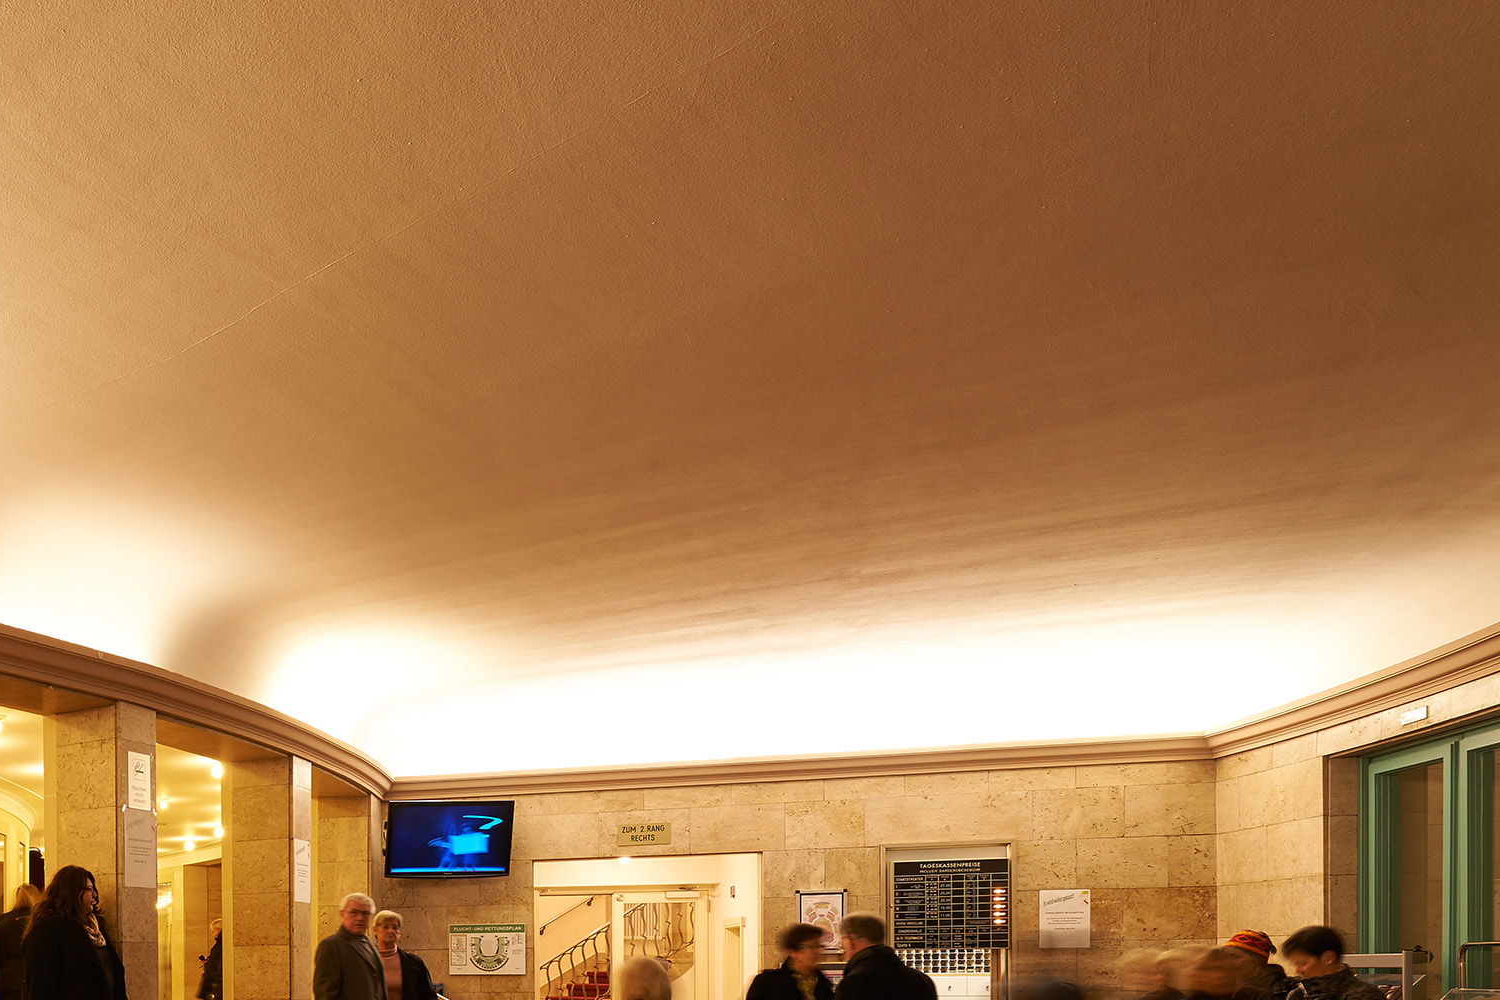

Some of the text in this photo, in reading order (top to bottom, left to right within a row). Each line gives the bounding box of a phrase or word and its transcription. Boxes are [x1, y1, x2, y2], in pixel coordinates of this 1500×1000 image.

[621, 826, 637, 834] ZUM
[646, 824, 665, 832] RANG
[630, 833, 656, 842] RECHTS
